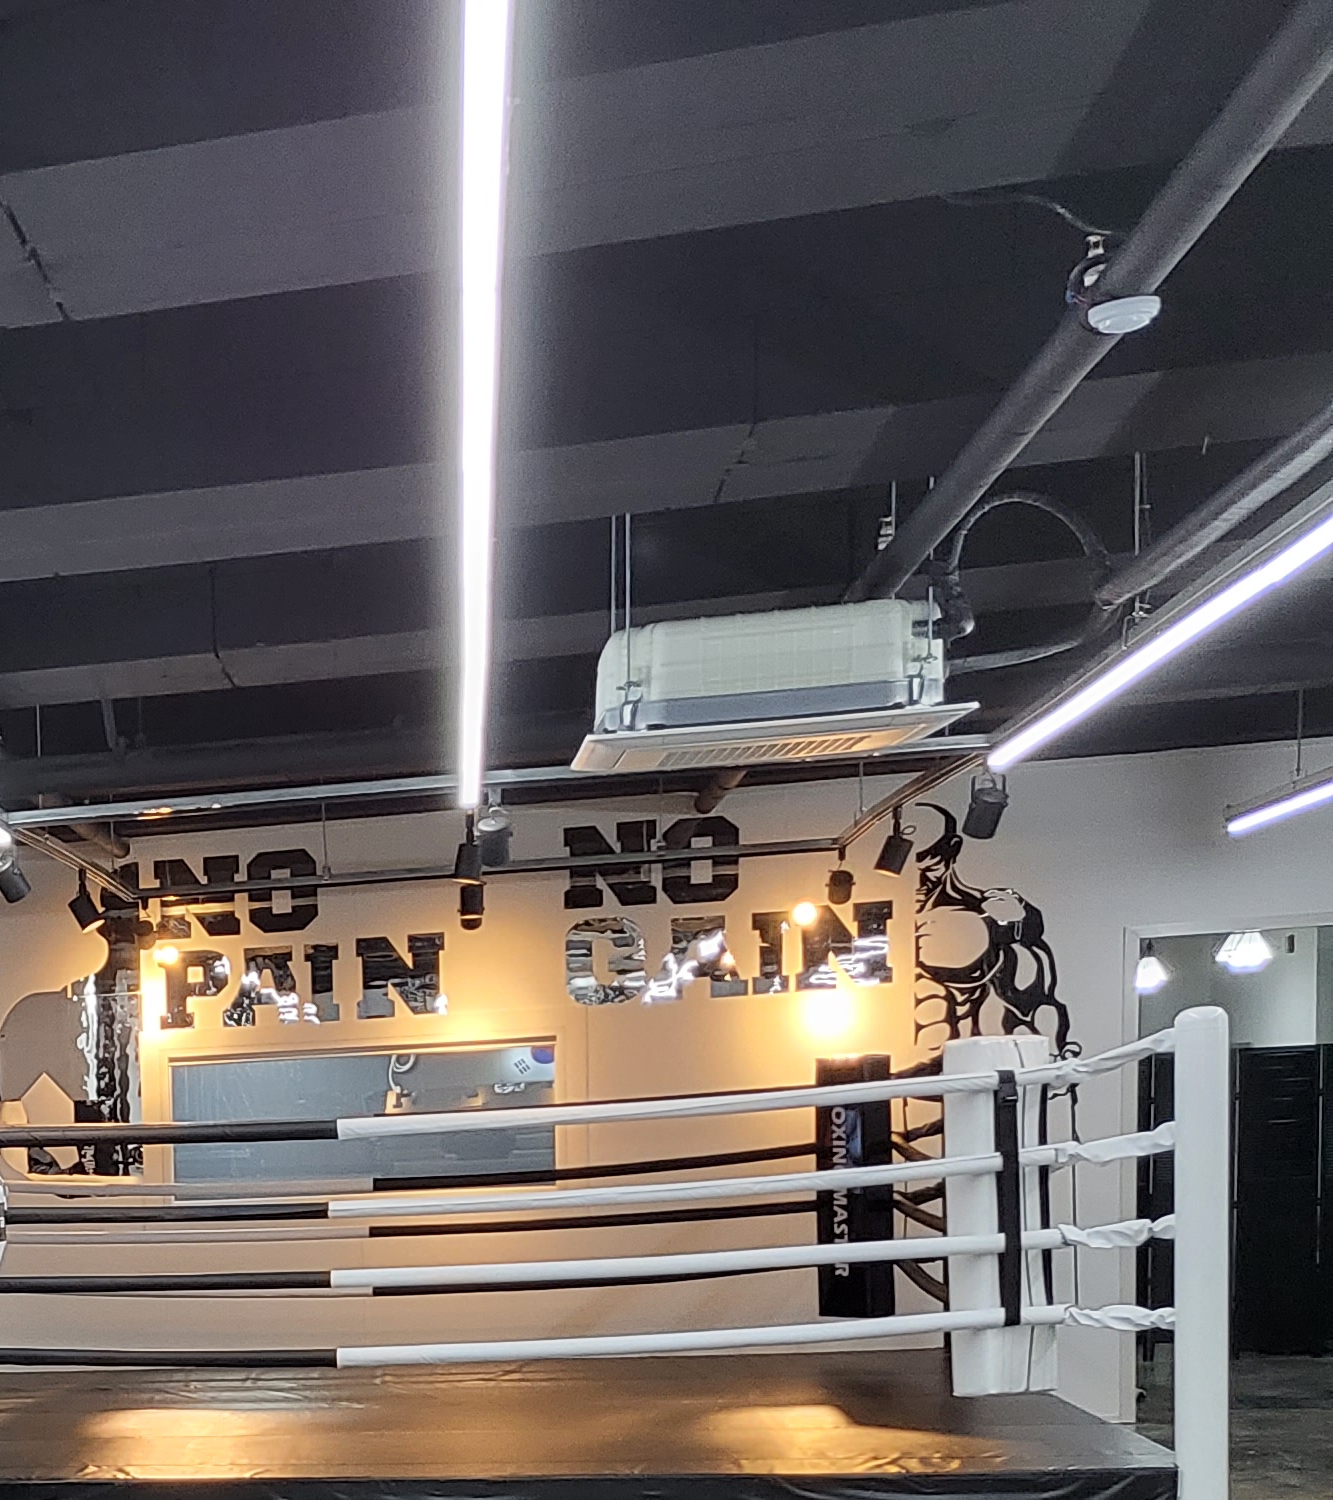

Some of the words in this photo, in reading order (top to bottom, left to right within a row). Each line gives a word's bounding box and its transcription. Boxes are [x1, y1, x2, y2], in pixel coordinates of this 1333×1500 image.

[153, 848, 319, 939] NO
[563, 815, 739, 909] NO
[157, 932, 446, 1029] PAIN
[565, 900, 894, 1005] GAIN
[831, 1106, 848, 1170] OXIN
[832, 1187, 849, 1278] MASTR
